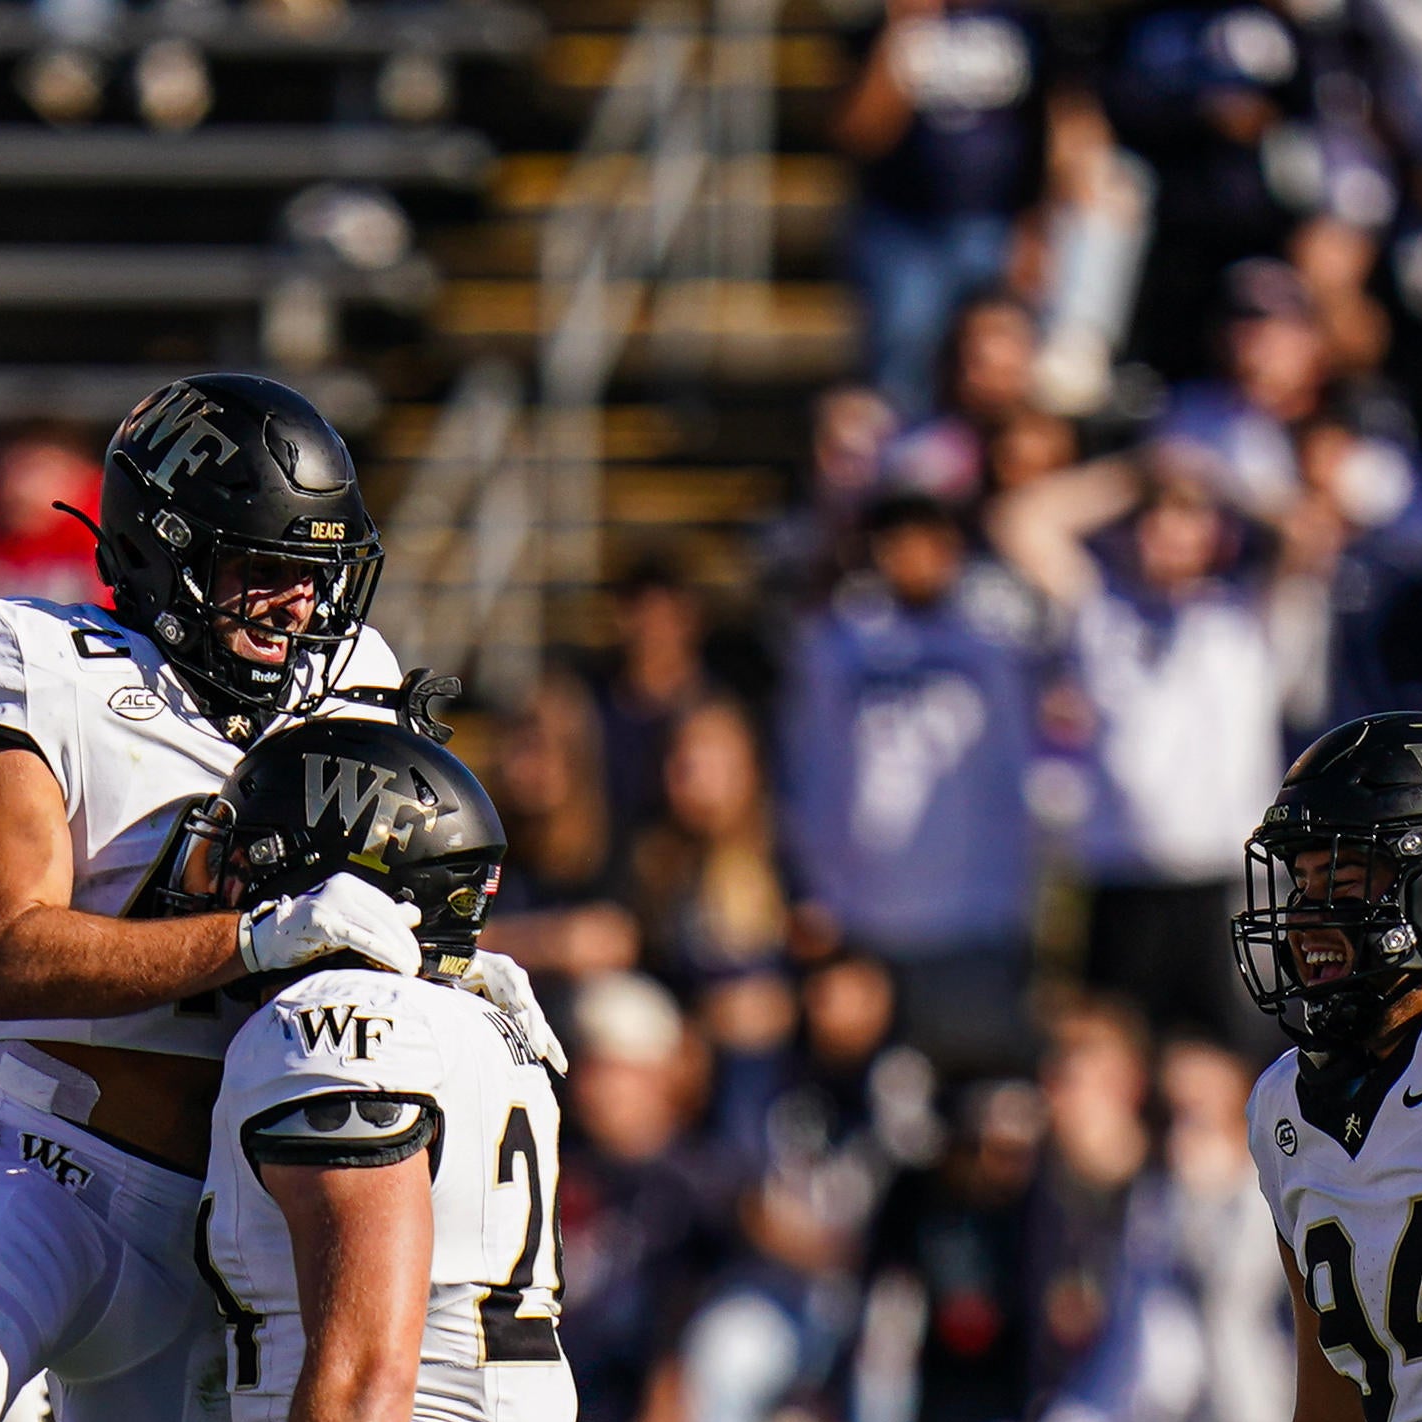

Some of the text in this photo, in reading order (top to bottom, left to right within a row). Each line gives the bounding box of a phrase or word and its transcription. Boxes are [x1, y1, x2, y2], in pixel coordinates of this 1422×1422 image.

[126, 381, 239, 494] WF
[311, 521, 345, 540] DEACS
[118, 693, 157, 707] ACC
[251, 668, 282, 684] Ridde
[303, 753, 437, 874] WF
[294, 1004, 394, 1061] WF
[19, 1132, 93, 1190] WF
